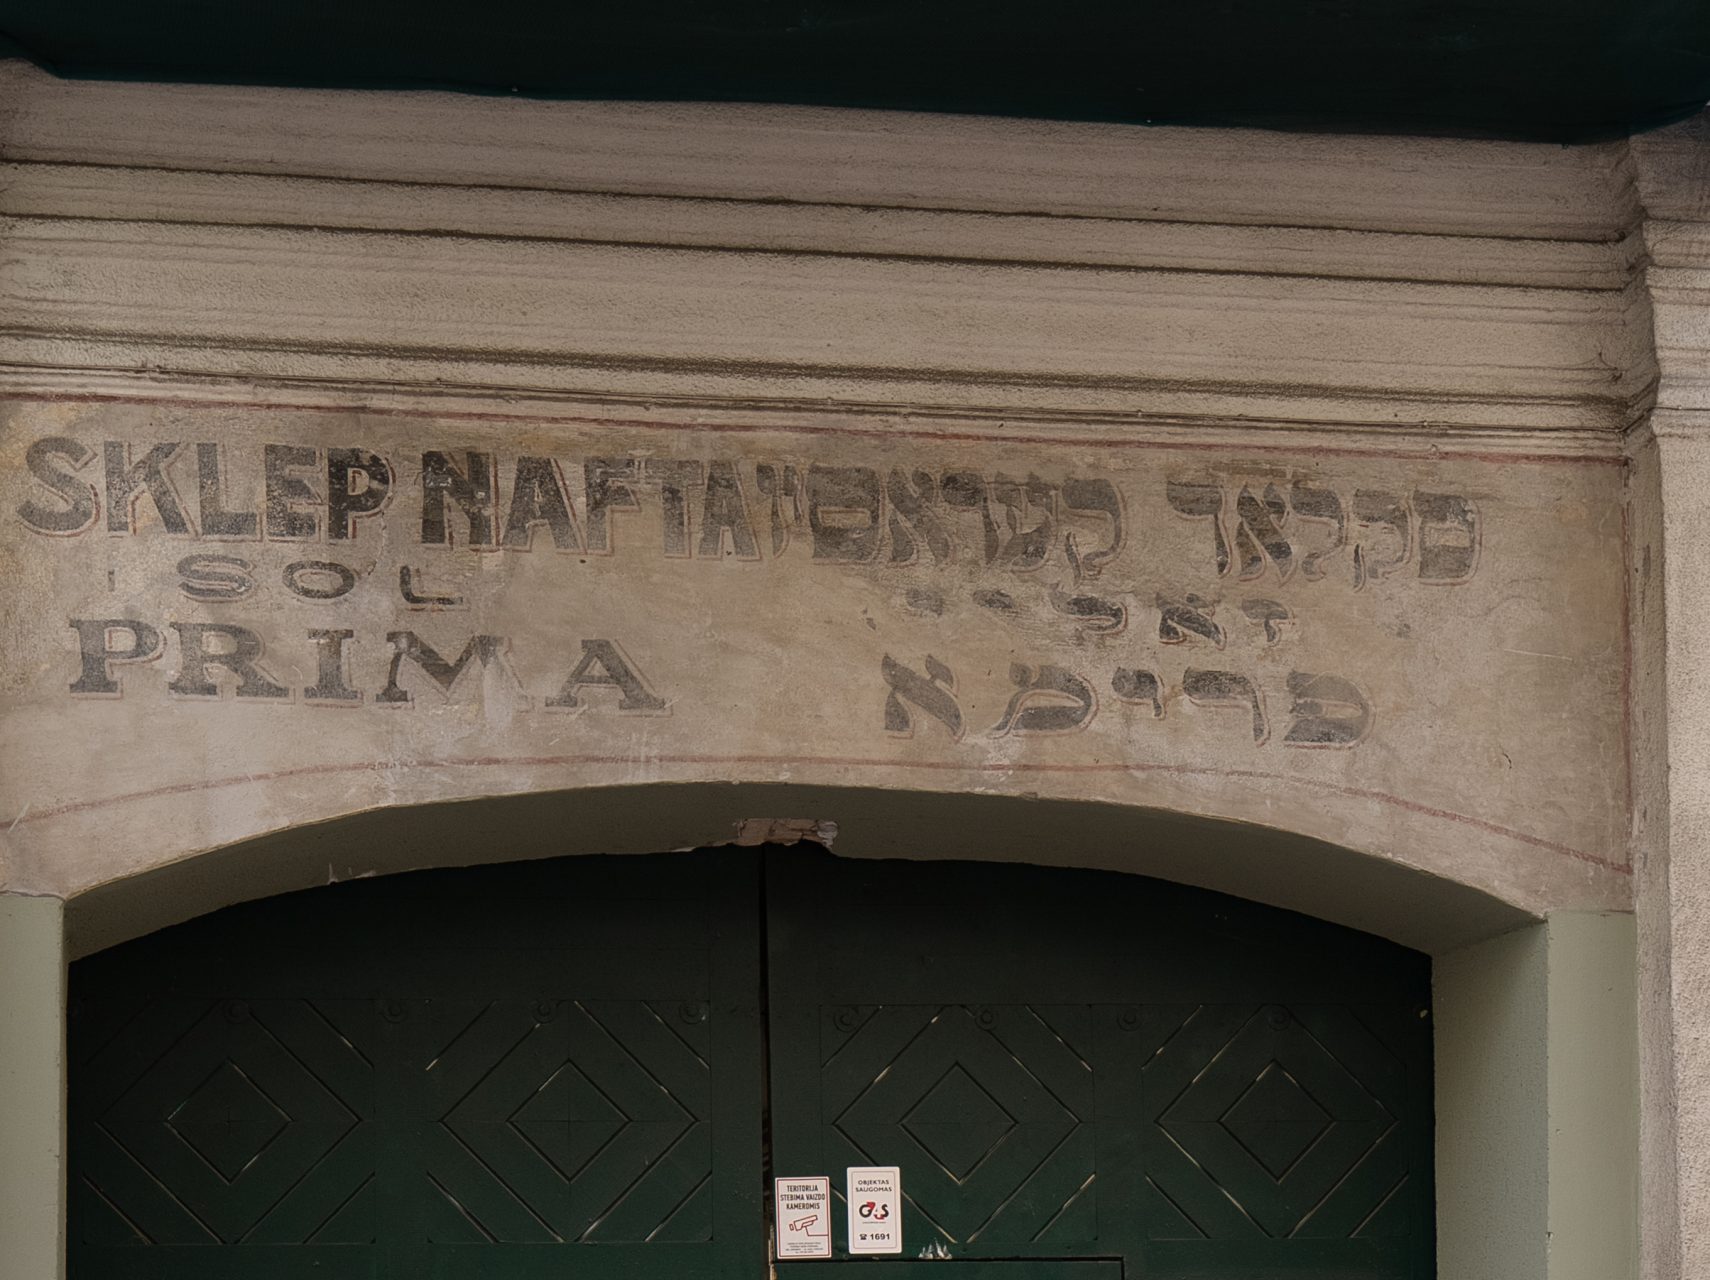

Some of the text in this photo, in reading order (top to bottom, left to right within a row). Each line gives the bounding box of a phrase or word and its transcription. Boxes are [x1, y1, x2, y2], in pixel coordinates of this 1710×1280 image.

[16, 437, 398, 544] SKLEP
[421, 450, 762, 562] NAFTA
[175, 552, 470, 612] SOL
[68, 618, 674, 718] PRIMA
[780, 1193, 826, 1202] STEBIMA VAIZDO
[786, 1184, 819, 1193] TERITORIJA
[785, 1202, 821, 1211] KAMEROMIS
[869, 1233, 891, 1241] 1691
